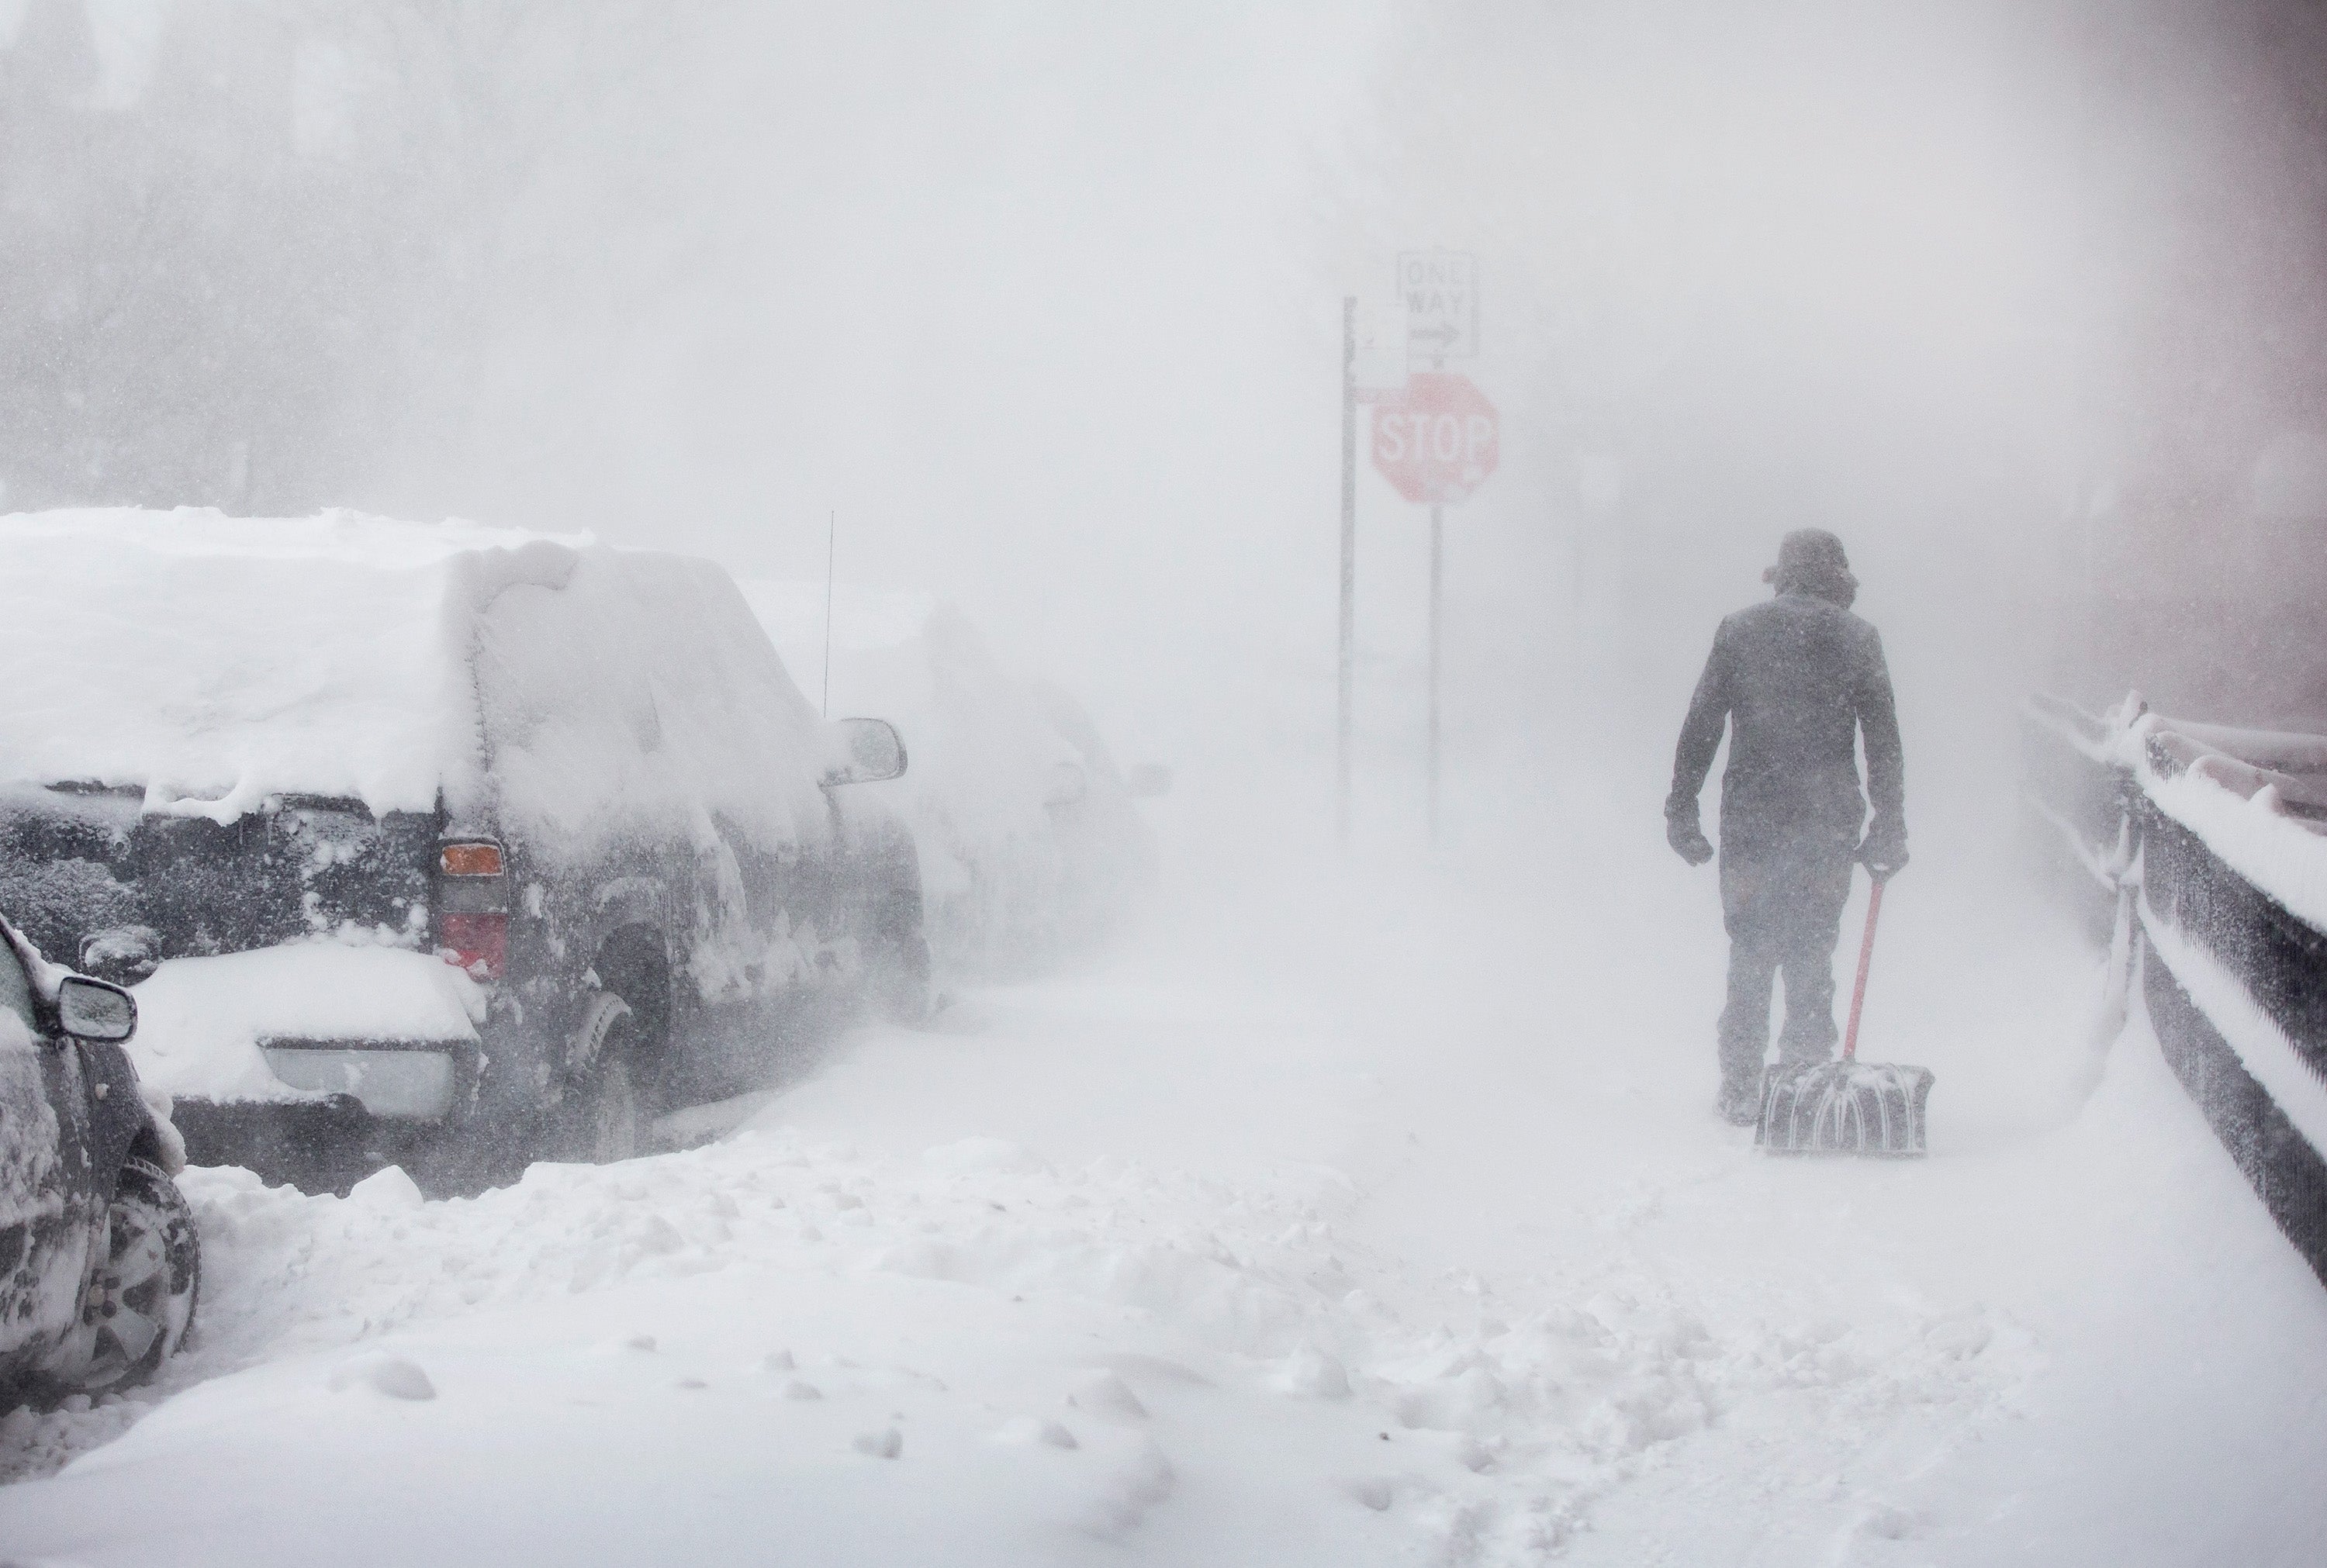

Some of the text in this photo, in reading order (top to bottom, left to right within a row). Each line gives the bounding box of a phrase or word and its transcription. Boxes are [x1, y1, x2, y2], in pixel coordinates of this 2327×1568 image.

[1407, 261, 1464, 285] ONE
[1406, 291, 1465, 313] WAY
[1379, 413, 1493, 463] STOP
